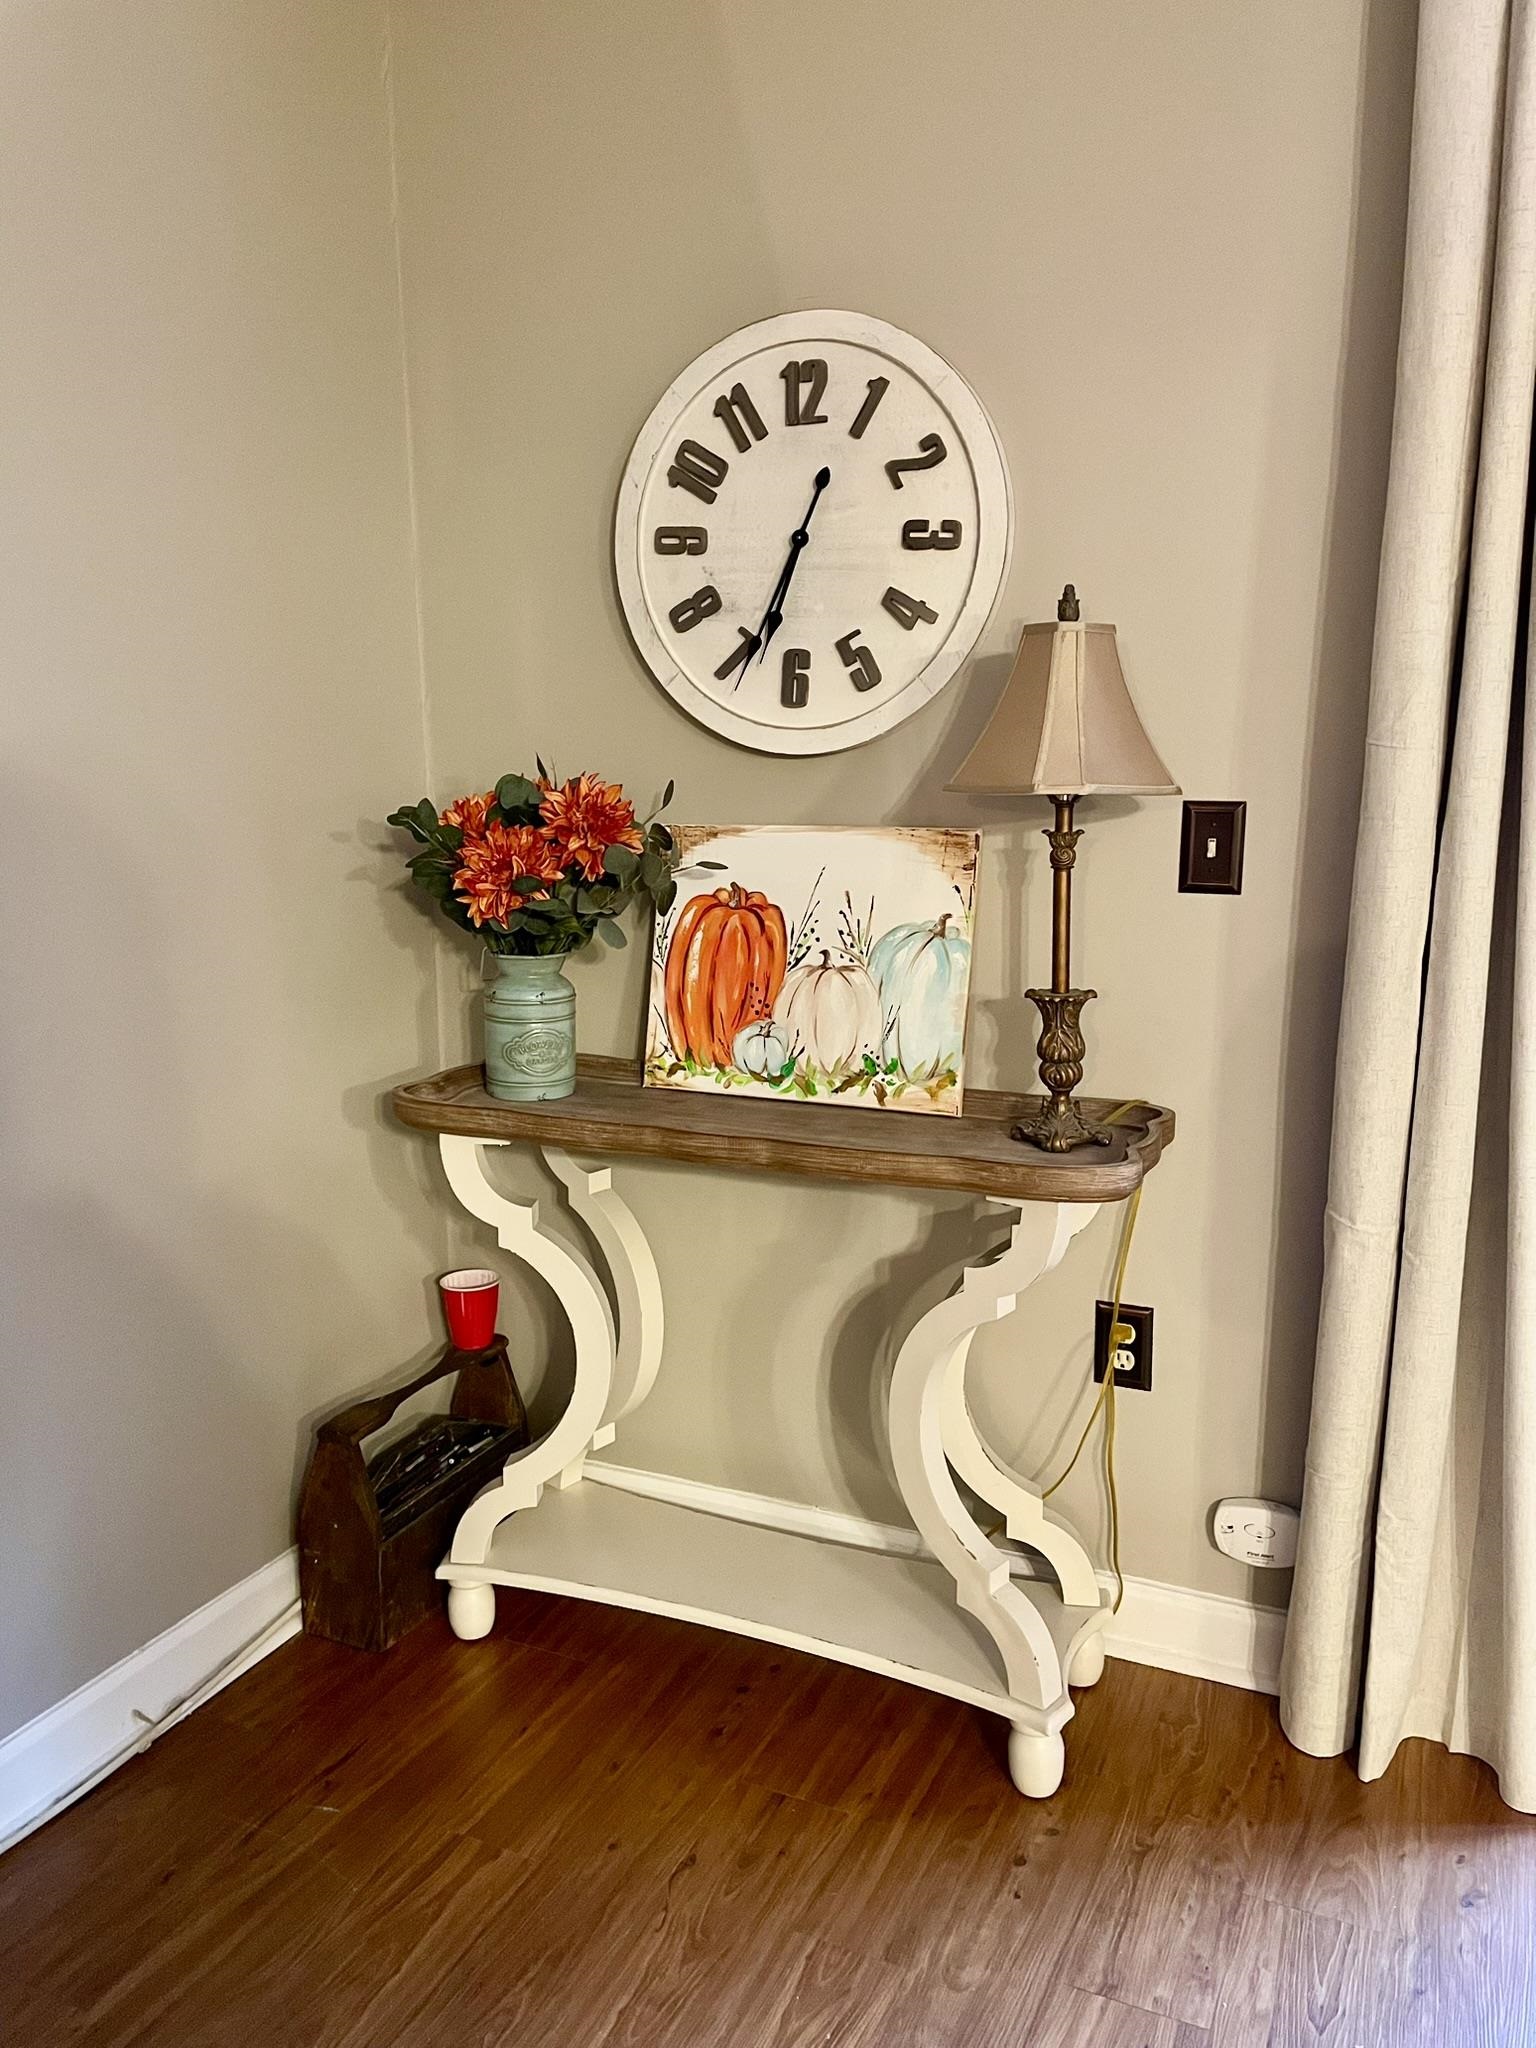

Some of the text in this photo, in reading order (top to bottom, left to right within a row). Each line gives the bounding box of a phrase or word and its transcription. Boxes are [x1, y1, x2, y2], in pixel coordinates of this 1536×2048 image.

[713, 382, 768, 453] 11
[779, 359, 828, 426] 12
[848, 376, 890, 439] 1
[667, 439, 728, 504] 10
[884, 432, 947, 490] 2
[654, 526, 708, 556] 9
[901, 519, 962, 551] 3
[669, 585, 722, 633] 8
[881, 586, 939, 631] 4
[714, 626, 758, 680] 7
[780, 648, 811, 708] 6
[835, 629, 882, 692] 5
